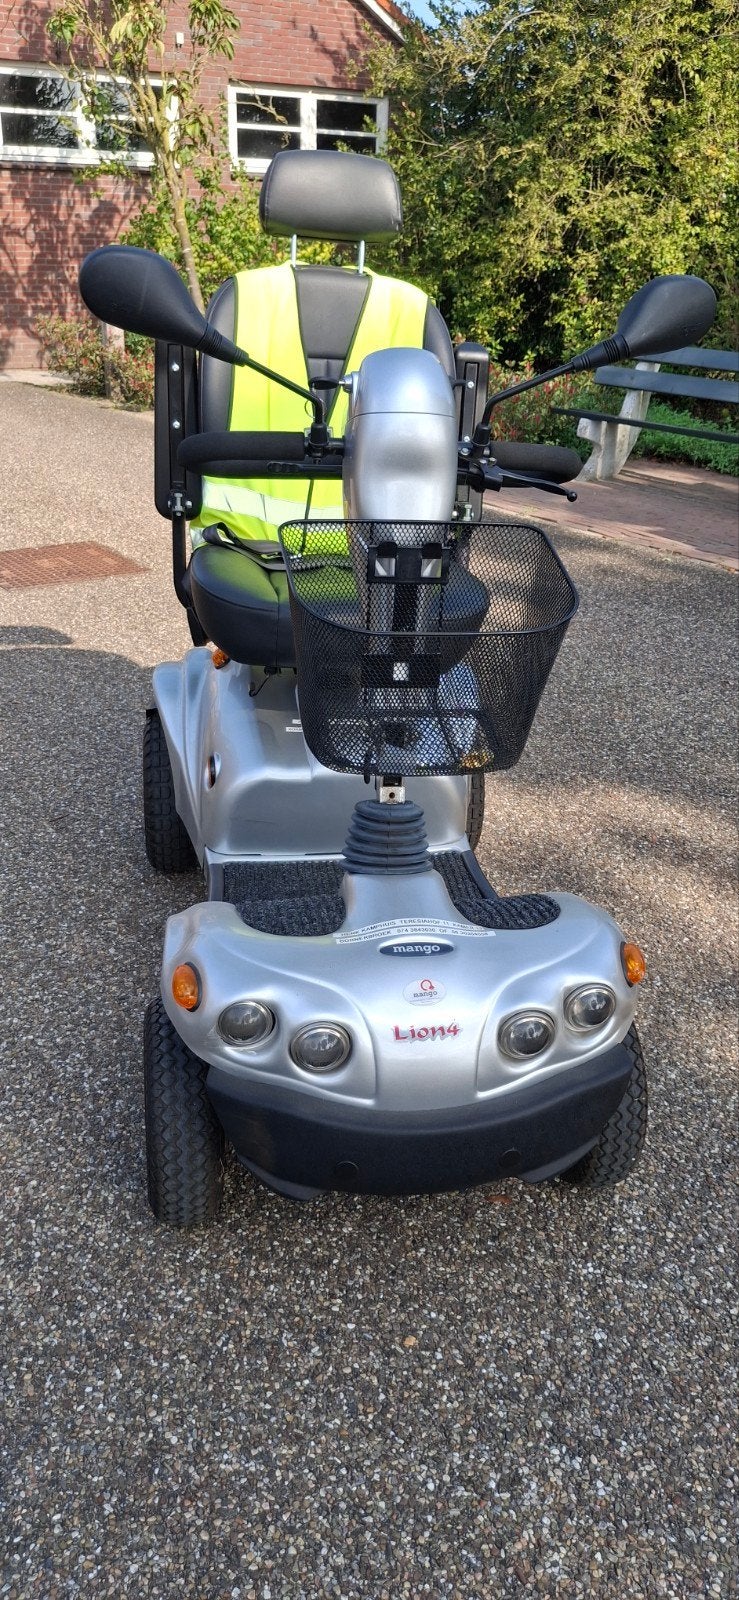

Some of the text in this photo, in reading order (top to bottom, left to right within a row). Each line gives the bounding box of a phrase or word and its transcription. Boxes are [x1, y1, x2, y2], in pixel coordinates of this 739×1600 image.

[393, 945, 441, 954] mango
[413, 990, 438, 998] mango
[393, 1022, 460, 1041] Lion4
